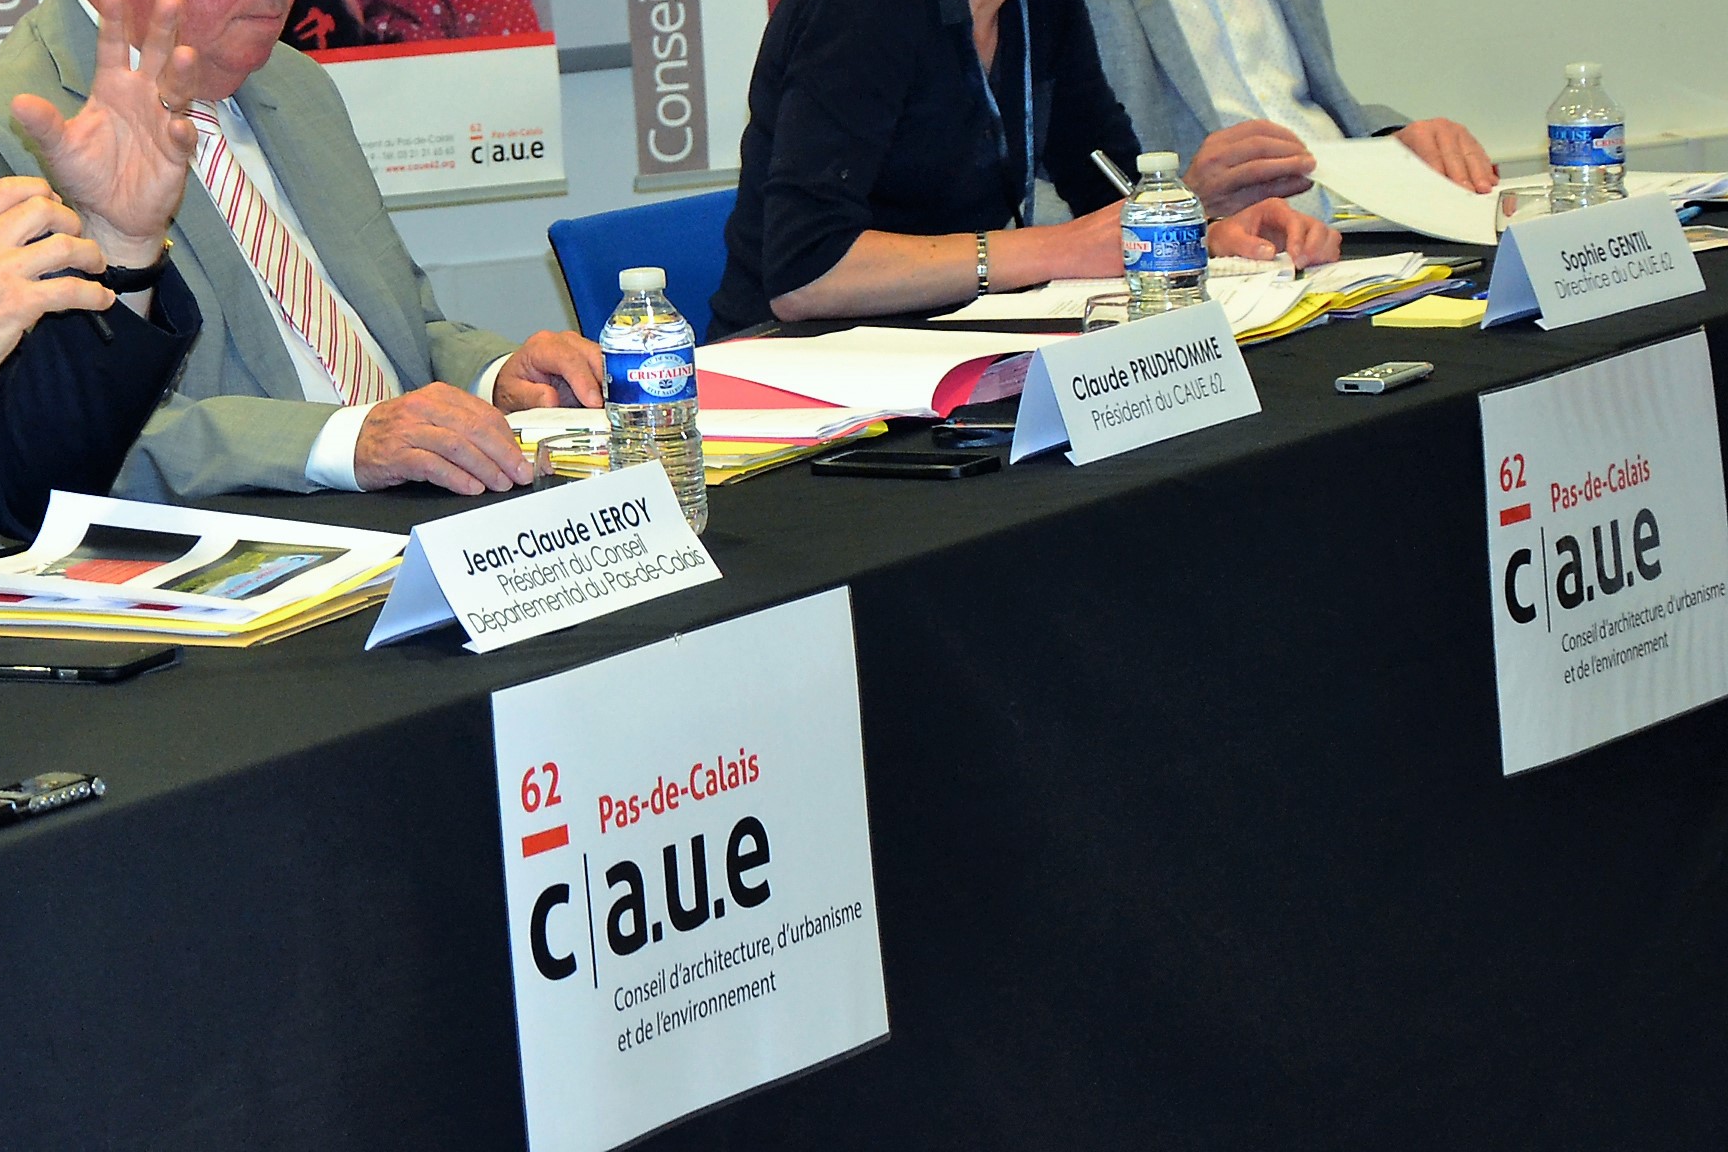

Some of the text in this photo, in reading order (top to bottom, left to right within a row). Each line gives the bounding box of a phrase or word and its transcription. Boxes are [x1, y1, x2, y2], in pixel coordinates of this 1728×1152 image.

[1153, 228, 1200, 243] LOUISE
[1561, 231, 1652, 273] Sophie GENTIL
[1555, 252, 1674, 299] Directrice du CAUE 62
[1073, 337, 1222, 400] Claude PRUDHOMME
[1092, 373, 1225, 430] Président du CAUE 62
[1500, 453, 1526, 492] 62
[1551, 455, 1650, 513] Pas-de-Calais
[464, 497, 651, 575] Jean-Claude LEROY
[498, 534, 647, 595] Président du Conseil
[468, 545, 706, 634] Départemental du Pas-de-Calais
[1562, 629, 1599, 653] Conseil
[1667, 582, 1726, 615] d'urbanisme
[1565, 632, 1668, 683] et de l'environnement
[520, 762, 562, 813] 62
[597, 747, 760, 834] Pas-de-Calais
[615, 902, 861, 1011] Conseil d'architecture, d'urbanisme
[618, 971, 776, 1051] et de l'environnement
